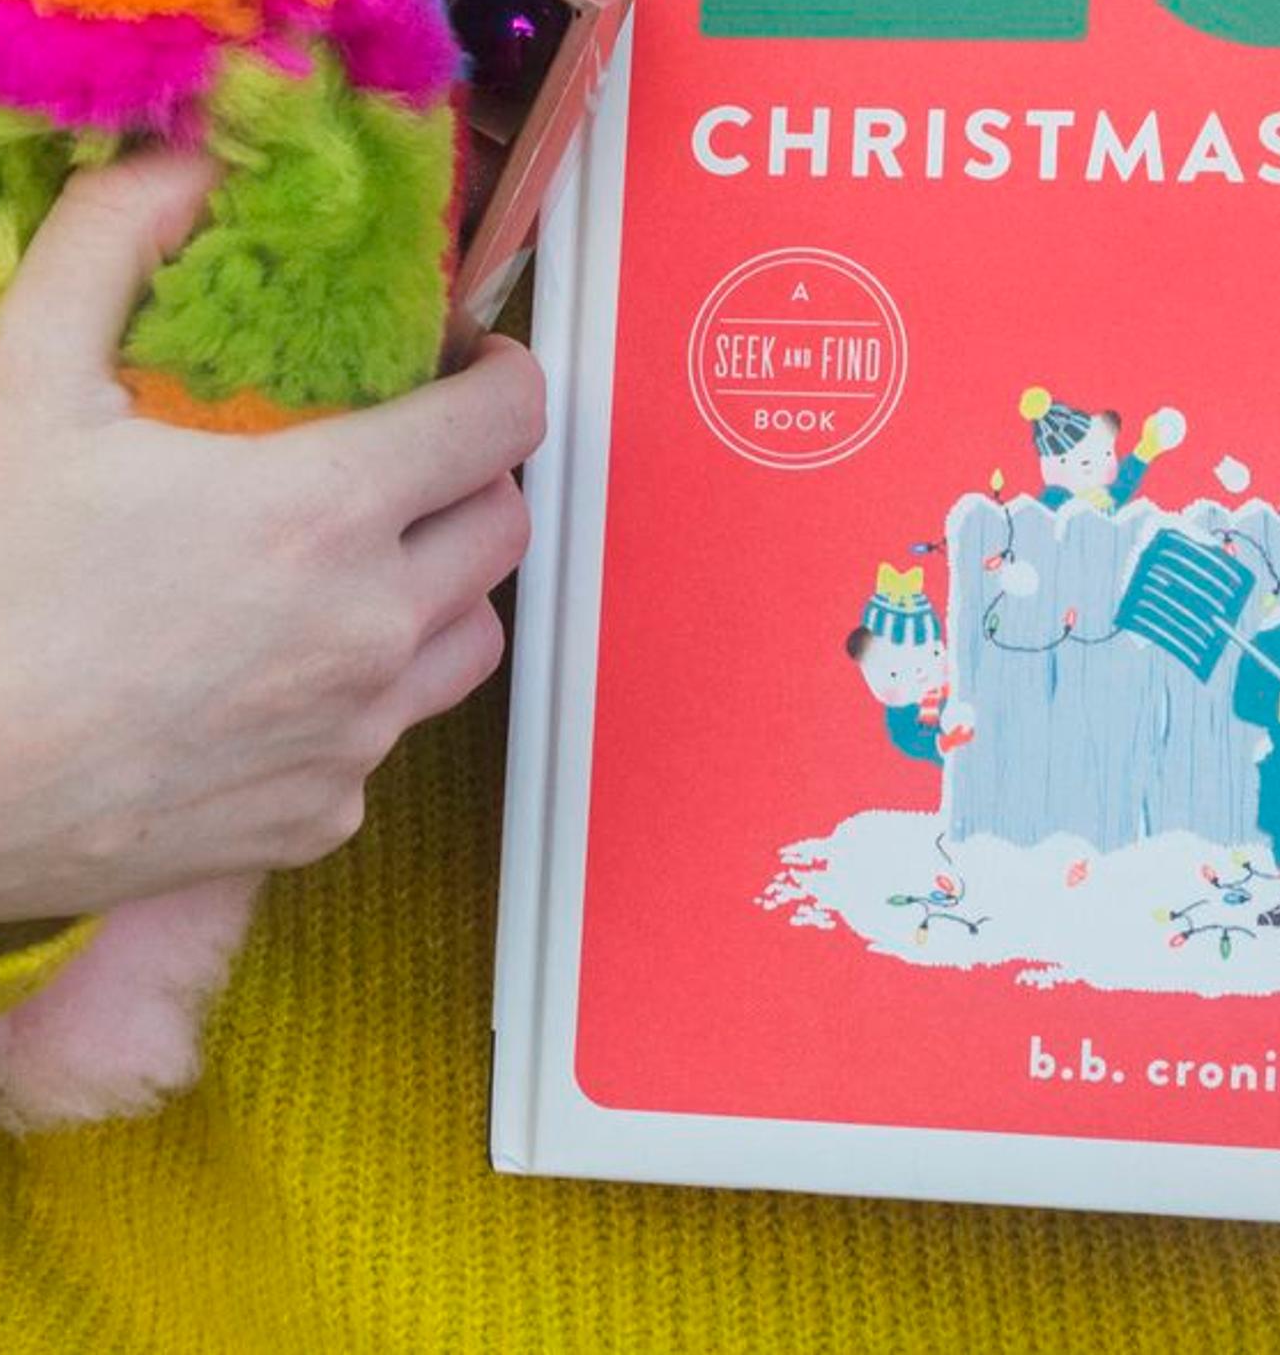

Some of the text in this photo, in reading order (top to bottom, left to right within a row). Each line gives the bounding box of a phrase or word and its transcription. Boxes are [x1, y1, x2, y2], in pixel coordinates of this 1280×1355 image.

[791, 280, 811, 302] A
[714, 334, 881, 383] SEEK AND FIND
[753, 408, 836, 433] BOOK
[1029, 1035, 1126, 1083] b.b.
